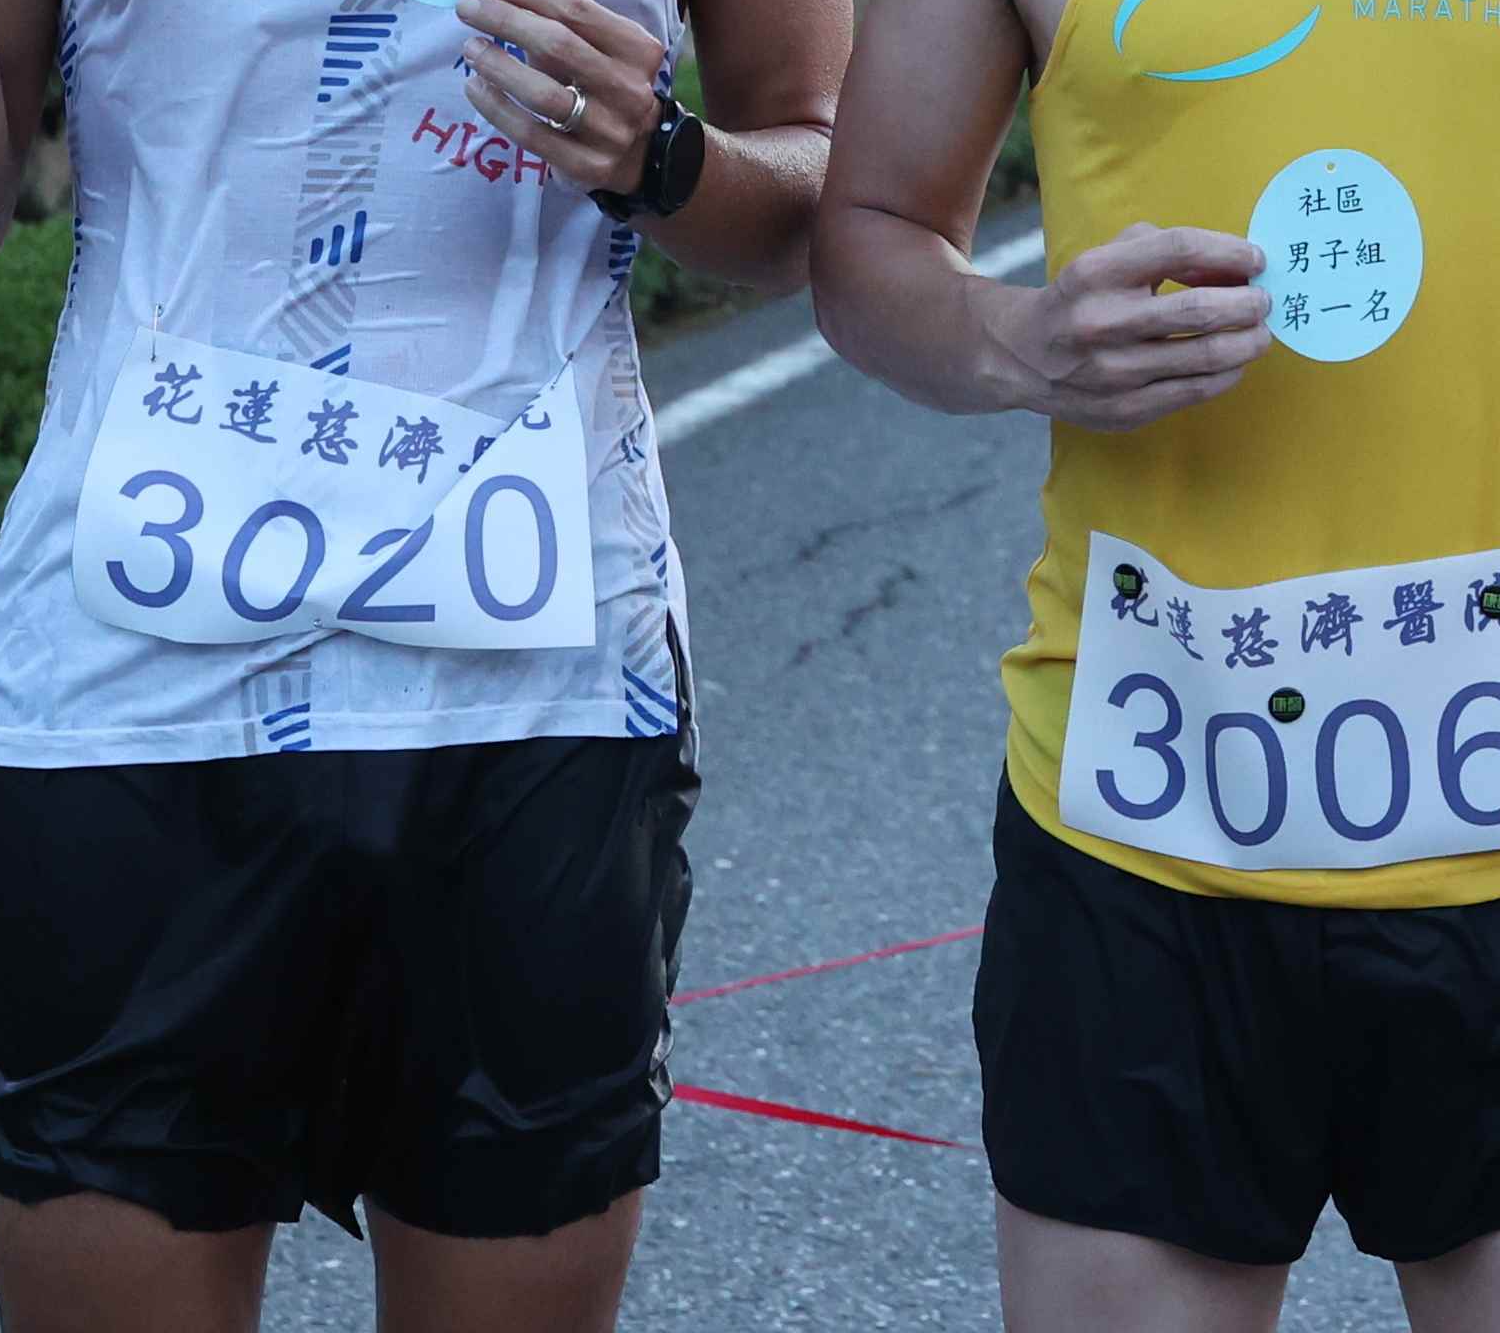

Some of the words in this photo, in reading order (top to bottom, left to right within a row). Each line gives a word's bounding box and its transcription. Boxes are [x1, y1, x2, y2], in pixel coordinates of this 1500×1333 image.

[1298, 183, 1364, 217] 社區
[1287, 238, 1386, 274] 男子組
[1282, 288, 1390, 332] 第一名
[105, 469, 558, 623] 3020
